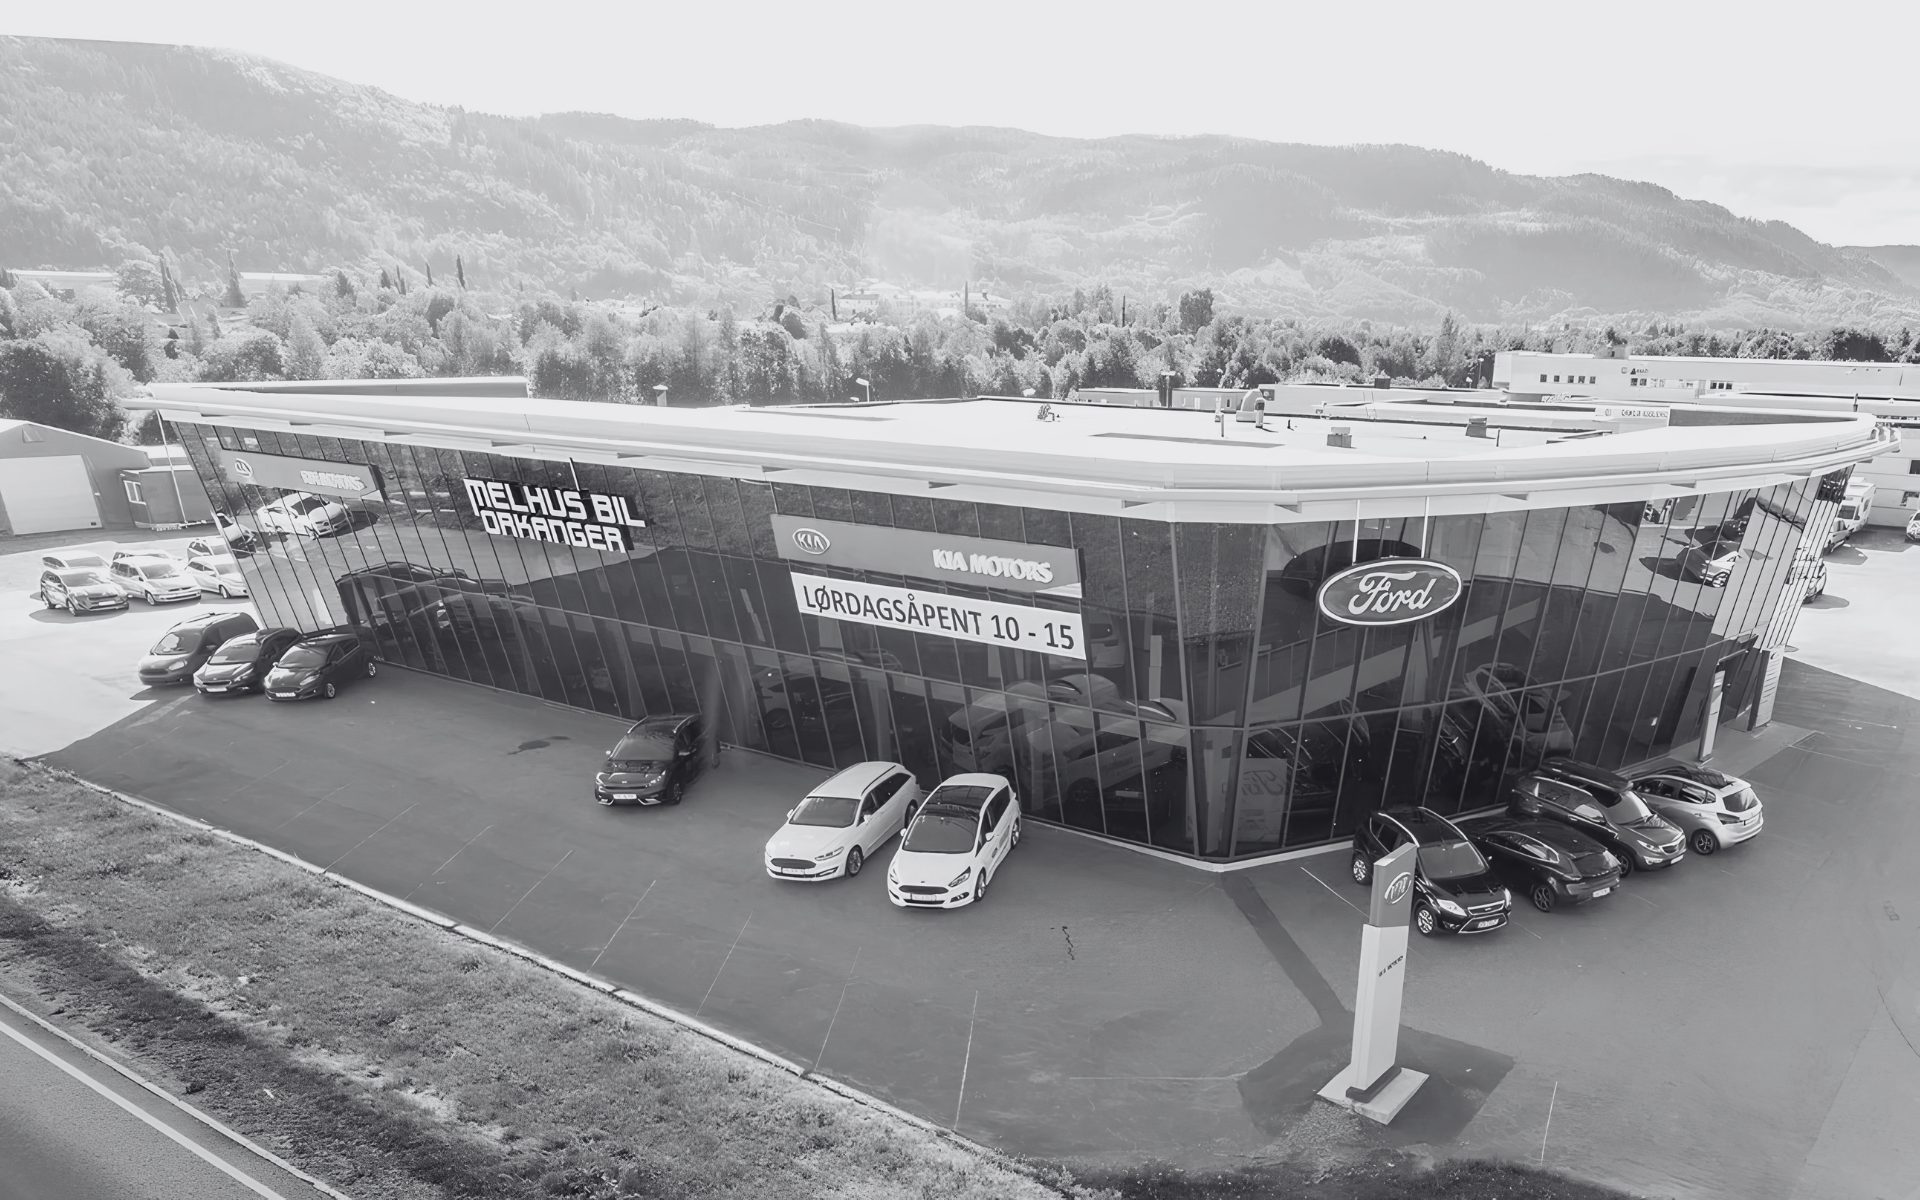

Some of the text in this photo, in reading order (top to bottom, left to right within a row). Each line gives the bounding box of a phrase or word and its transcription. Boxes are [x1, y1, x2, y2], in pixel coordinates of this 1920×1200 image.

[463, 478, 647, 528] MELHUS BIL
[480, 510, 626, 553] ORKANGER
[797, 533, 825, 550] KIA
[932, 549, 1054, 584] KIA MOTORS
[1348, 571, 1437, 615] Ford
[803, 585, 982, 635] LØRDAGSÅPENT
[990, 615, 1020, 642] 10
[1044, 622, 1075, 650] 15
